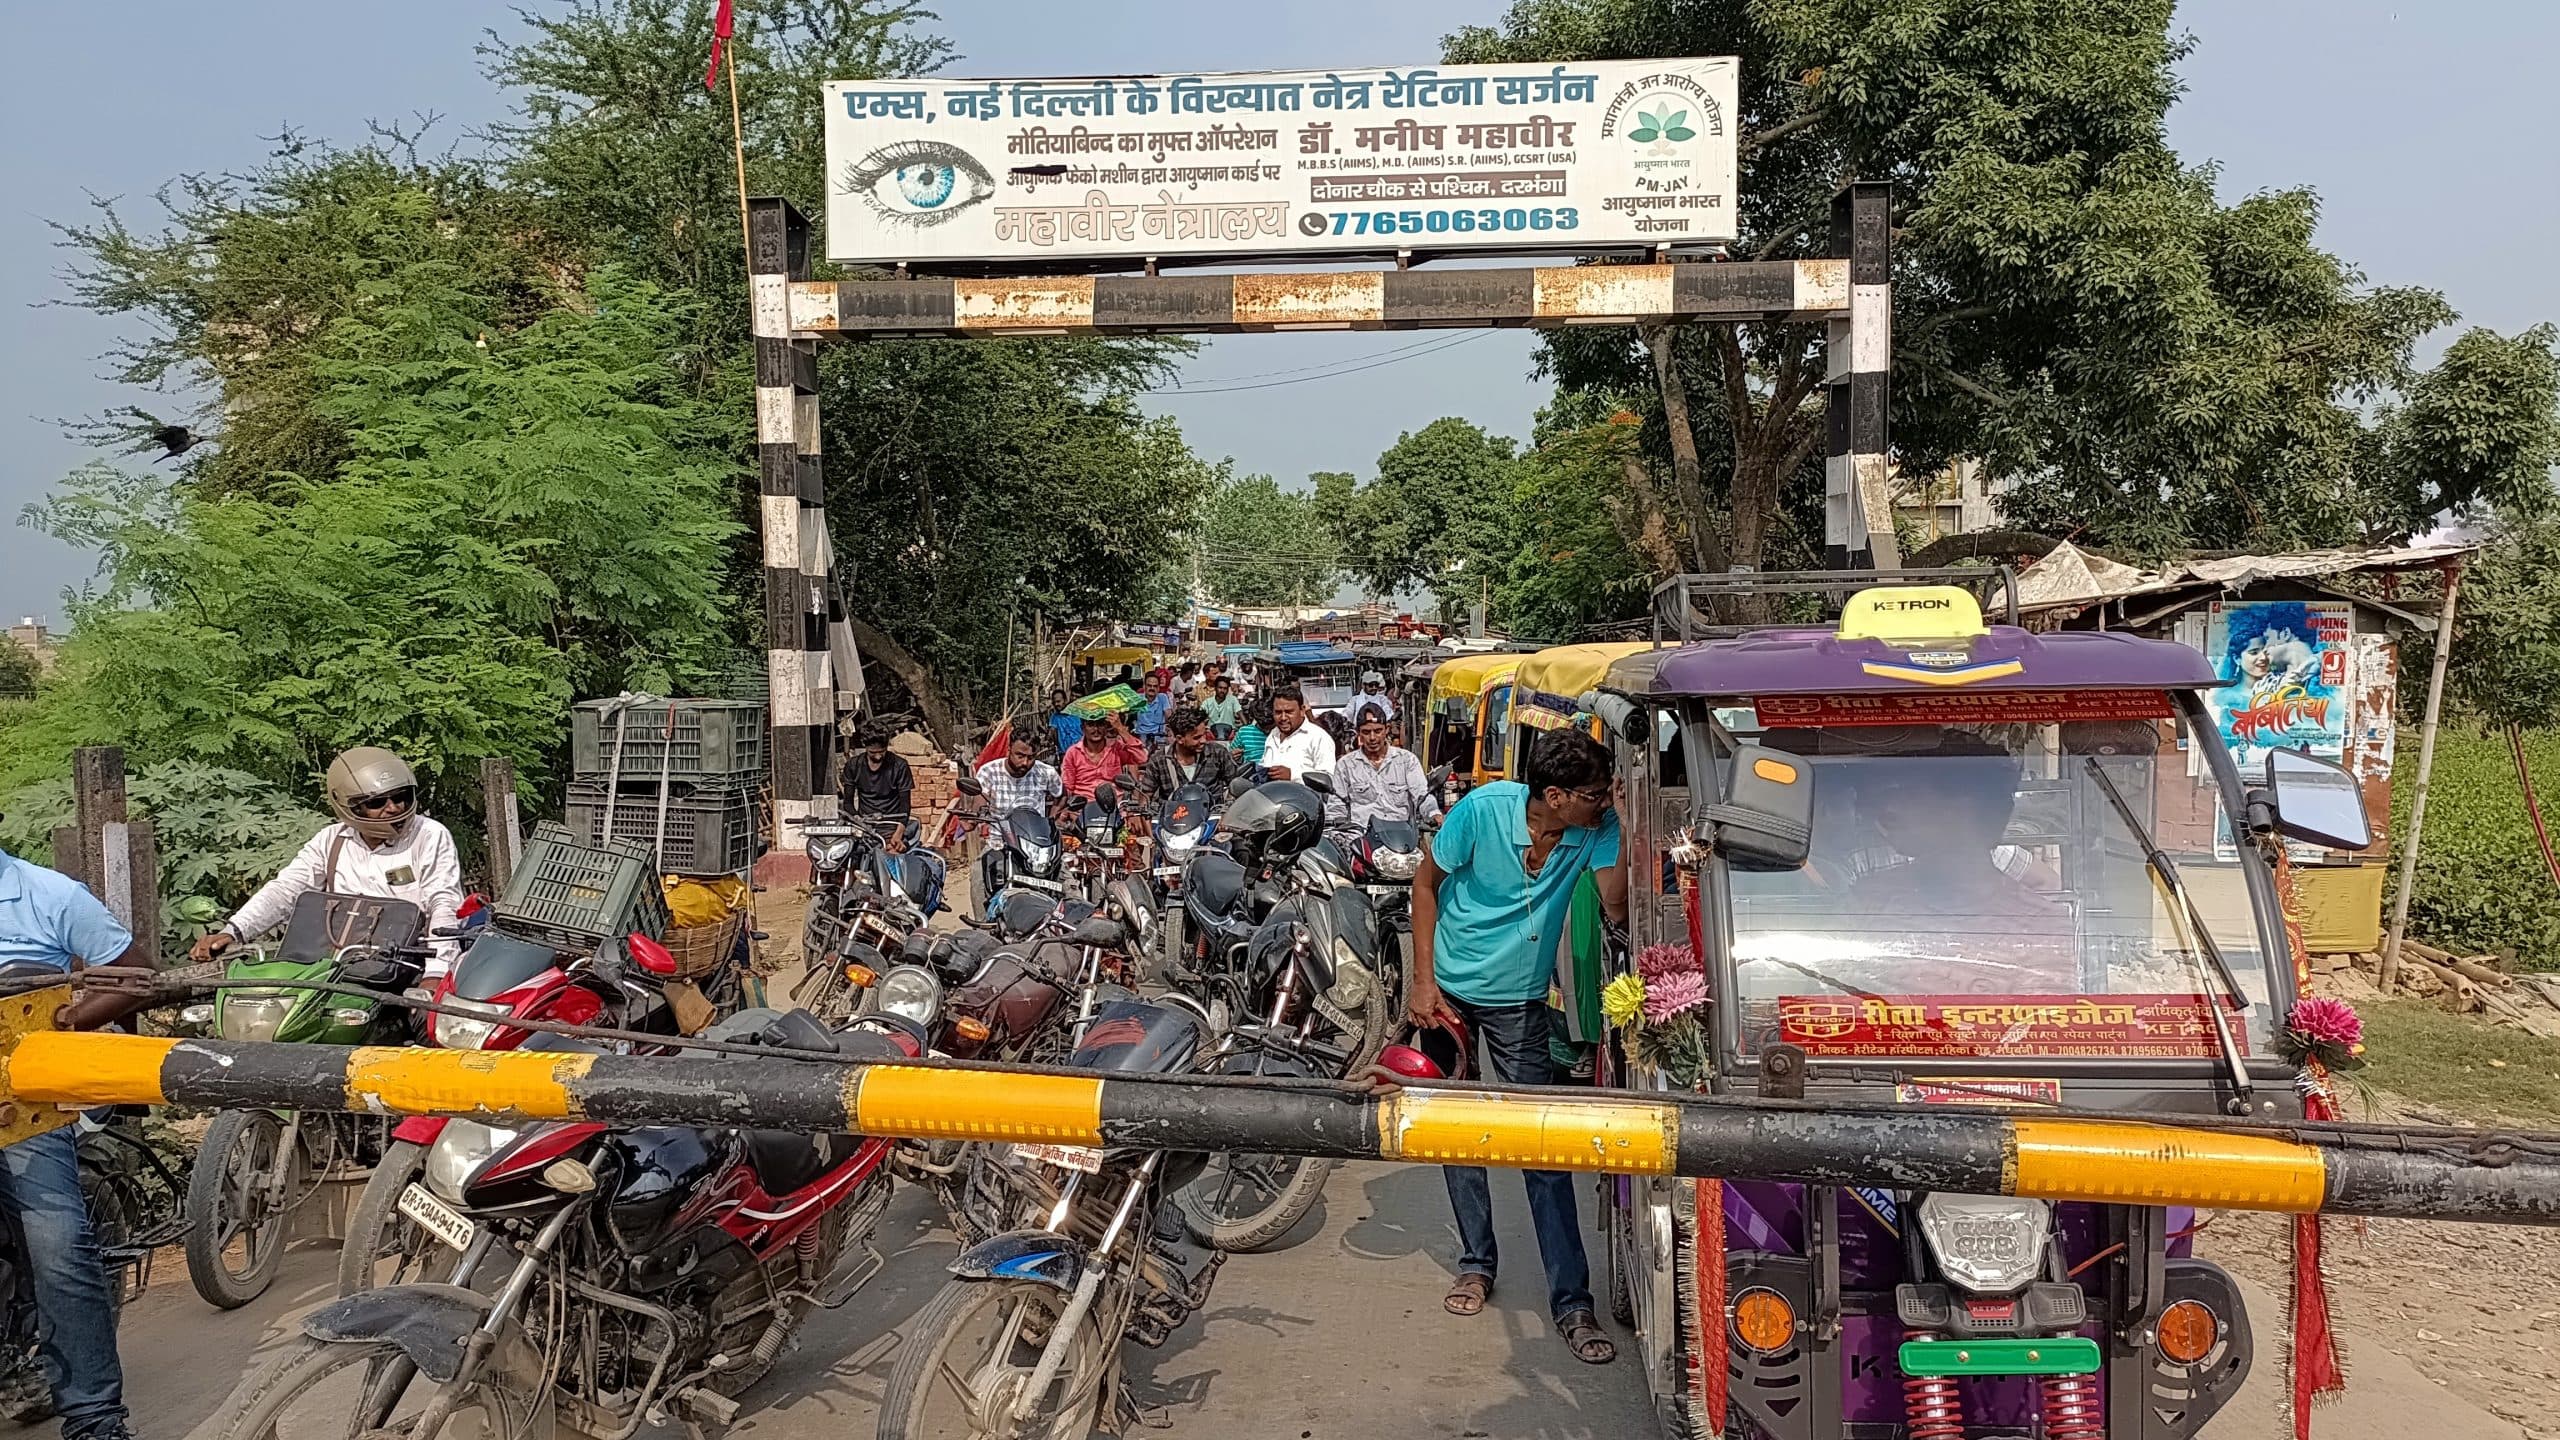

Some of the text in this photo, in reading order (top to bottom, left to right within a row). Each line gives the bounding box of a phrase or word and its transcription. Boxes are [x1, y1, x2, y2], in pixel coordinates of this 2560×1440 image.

[843, 66, 1599, 124] एम्स, नई दिल्ली के विख्यात नेत्र रेटिना सर्जन
[1601, 73, 1723, 140] प्रधानमंत्री जन आरोग्य योजना
[1007, 123, 1278, 163] मोतियाबिन्द का मुफ्त ऑपरेशन
[1298, 115, 1576, 155] डॉ. मनीष महावीर
[1298, 152, 1577, 170] M.B.B.S (AIIMS), M.D. (AIIMS) S.R. (AIIMS), GCSRT (USA)
[1634, 159, 1690, 171] आयुष्मान भारत
[1066, 164, 1097, 185] फेको
[1100, 163, 1138, 183] मशीन
[1141, 167, 1167, 186] द्वारा
[1170, 166, 1229, 190] आयुष्मान
[1232, 160, 1259, 182] कार्ड
[1262, 165, 1281, 180] पर
[1312, 173, 1564, 199] दोनार चौक से पश्चिम, दरभंगा
[1635, 175, 1690, 192] PM-JAY
[993, 189, 1289, 245] महावीर नेत्रालय
[1602, 194, 1721, 217] आयुष्मान भारत
[1328, 207, 1579, 235] 7765063063
[1634, 214, 1690, 232] योजना
[1874, 599, 1950, 611] KETRON
[2318, 630, 2347, 642] SOON
[2323, 677, 2342, 685] OTT
[1795, 1015, 1848, 1024] KETRON
[1859, 999, 1927, 1027] रीता
